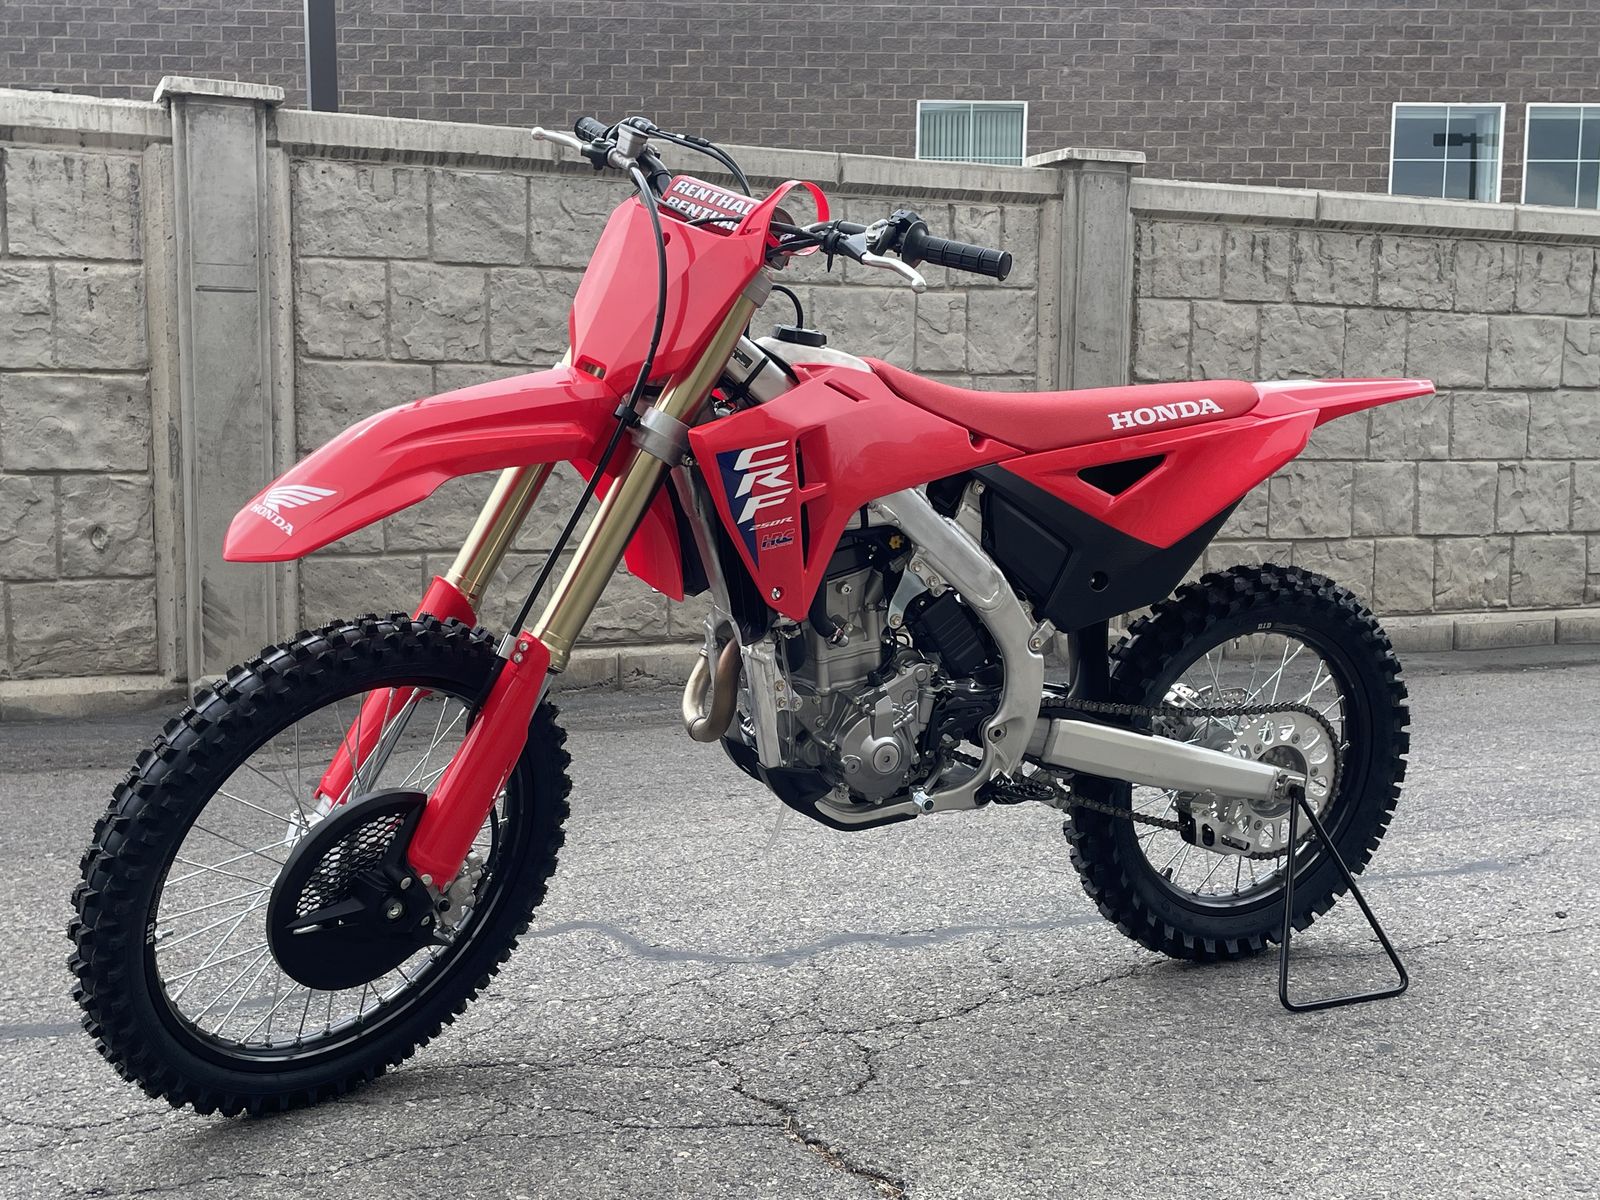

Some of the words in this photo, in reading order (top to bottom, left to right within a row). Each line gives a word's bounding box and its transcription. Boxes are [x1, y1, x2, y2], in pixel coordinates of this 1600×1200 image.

[673, 180, 754, 215] RENTHAL
[1107, 398, 1224, 430] HONDA
[733, 439, 793, 524] CRF
[250, 503, 294, 536] HONDA
[748, 516, 794, 531] 250R
[761, 528, 795, 550] HRC
